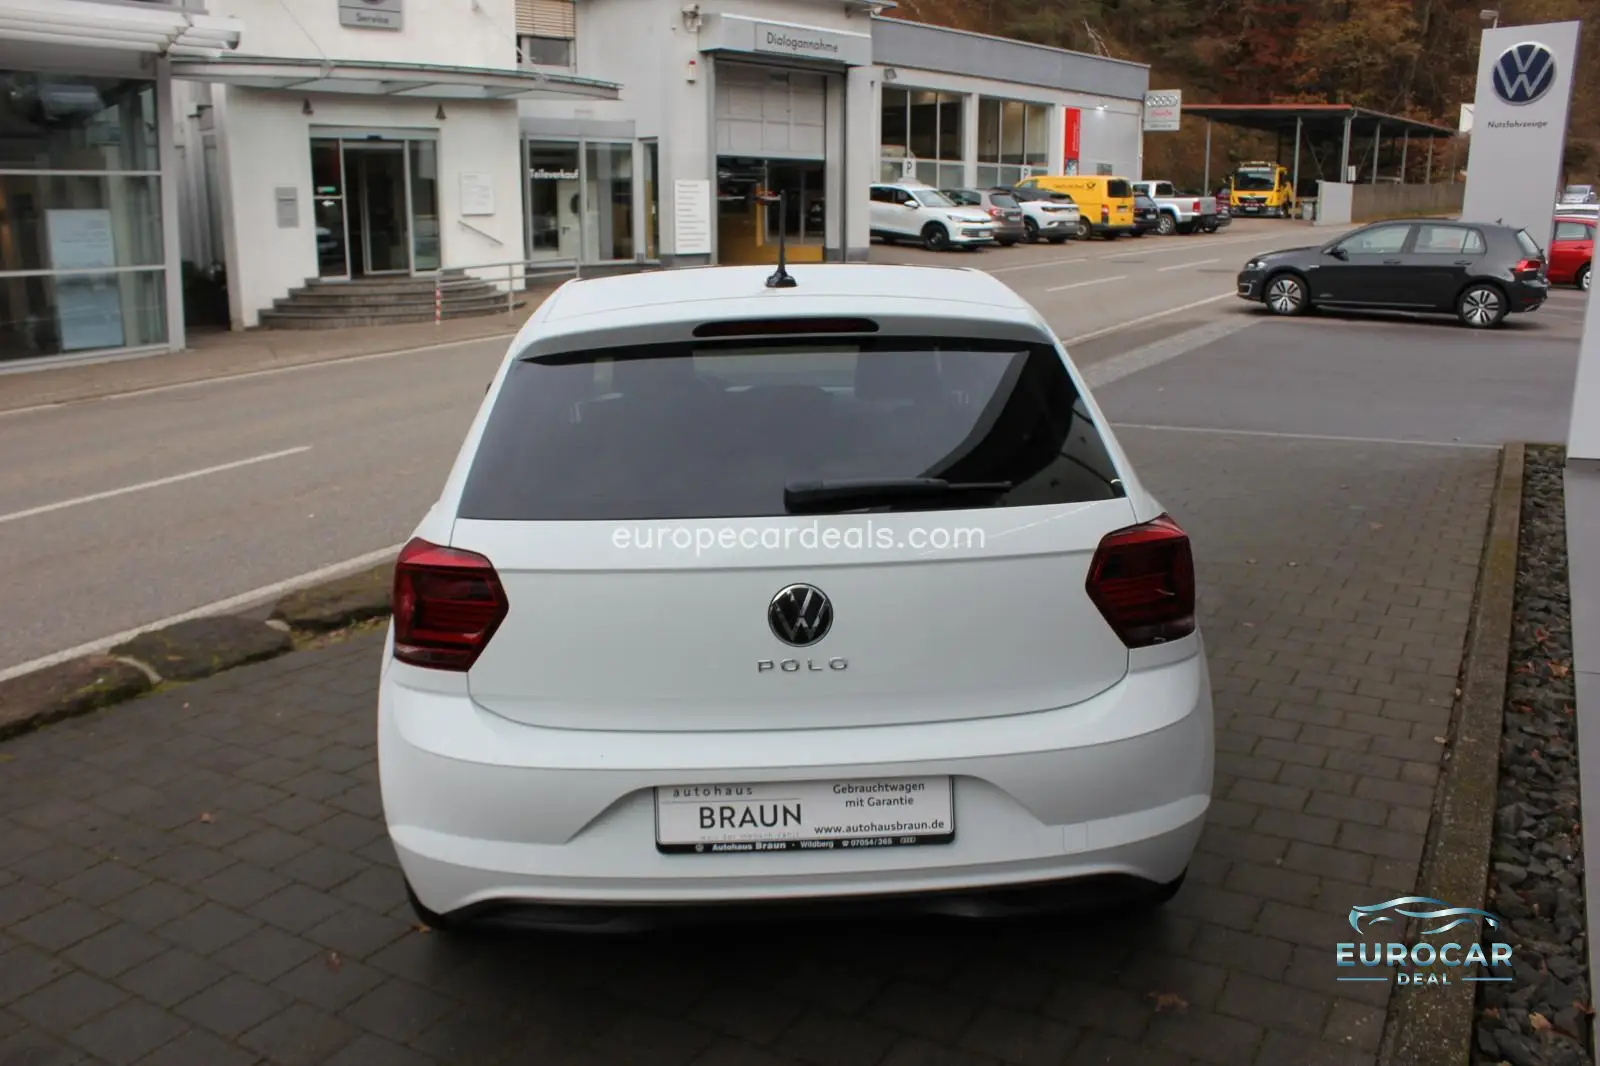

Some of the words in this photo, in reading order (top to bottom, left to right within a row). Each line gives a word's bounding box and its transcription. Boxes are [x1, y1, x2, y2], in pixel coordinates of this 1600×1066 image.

[356, 12, 389, 24] Service
[766, 31, 839, 54] Dialogannahme
[1487, 120, 1548, 130] Nutzfahrzeuge
[757, 656, 848, 673] POLO
[673, 785, 753, 798] autohaus
[833, 782, 925, 795] Gebrauchtwagen
[845, 796, 864, 807] mit
[867, 795, 914, 807] Garantie
[699, 802, 802, 830] BRAUN
[814, 819, 945, 835] www.autohausbraun.de
[711, 841, 753, 852] Autohaus
[755, 840, 787, 850] Braun
